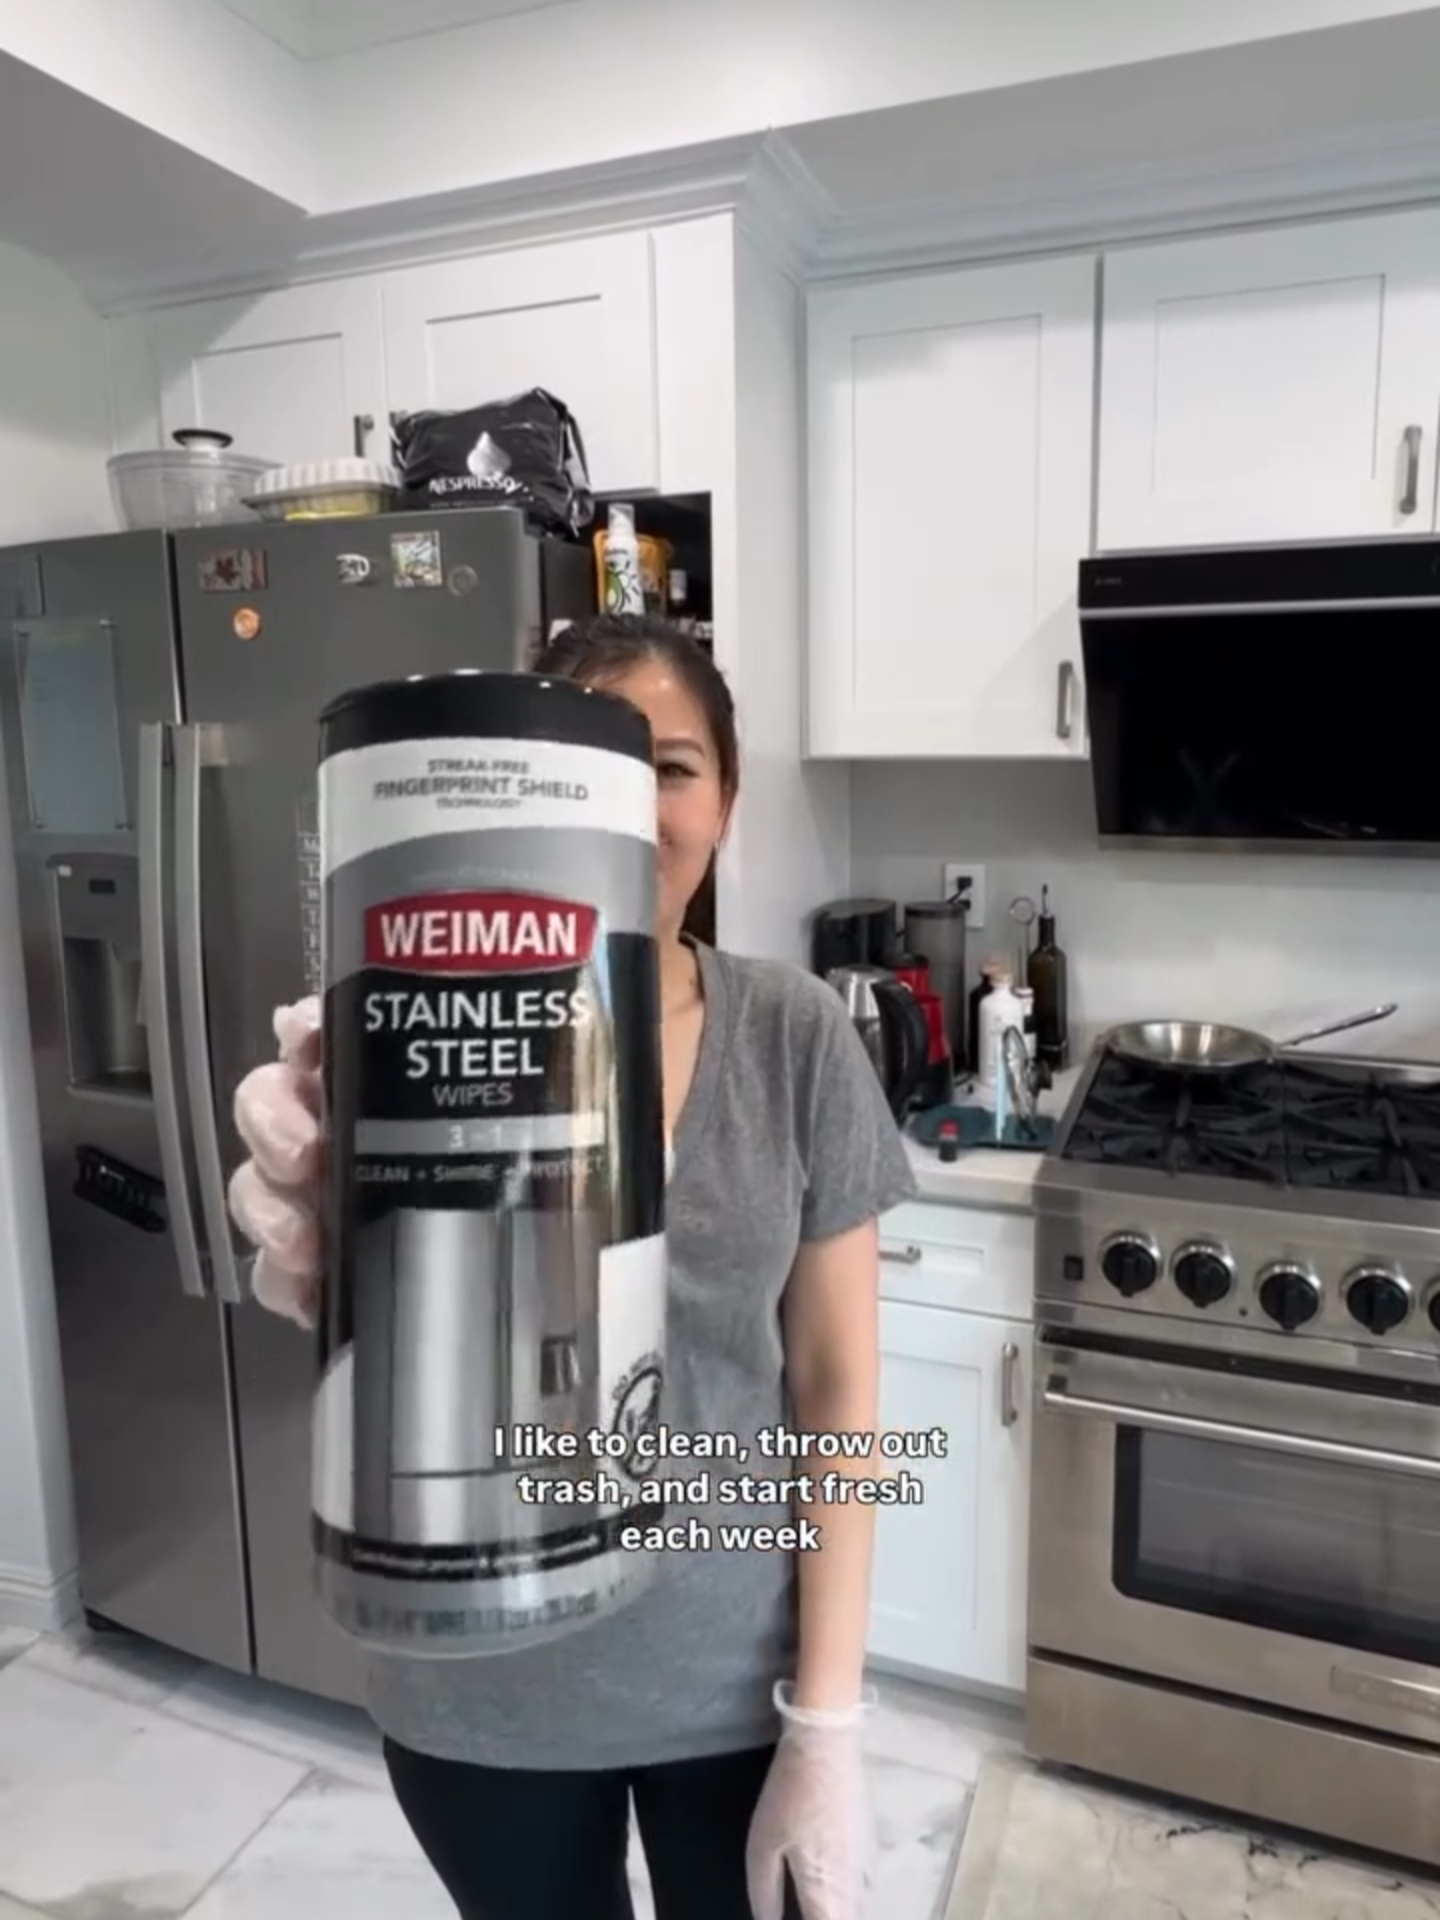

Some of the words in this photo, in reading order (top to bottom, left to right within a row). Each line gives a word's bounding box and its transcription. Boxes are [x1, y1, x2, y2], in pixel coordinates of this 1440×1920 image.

[429, 473, 516, 494] NESPRESSO
[518, 779, 588, 800] SHIELD
[380, 911, 577, 958] WEIMAN
[365, 989, 593, 1031] STAINLESS
[406, 1039, 544, 1078] STEEL
[432, 1082, 514, 1106] WIPES
[450, 1125, 463, 1148] 3
[355, 1165, 410, 1183] CLEAN
